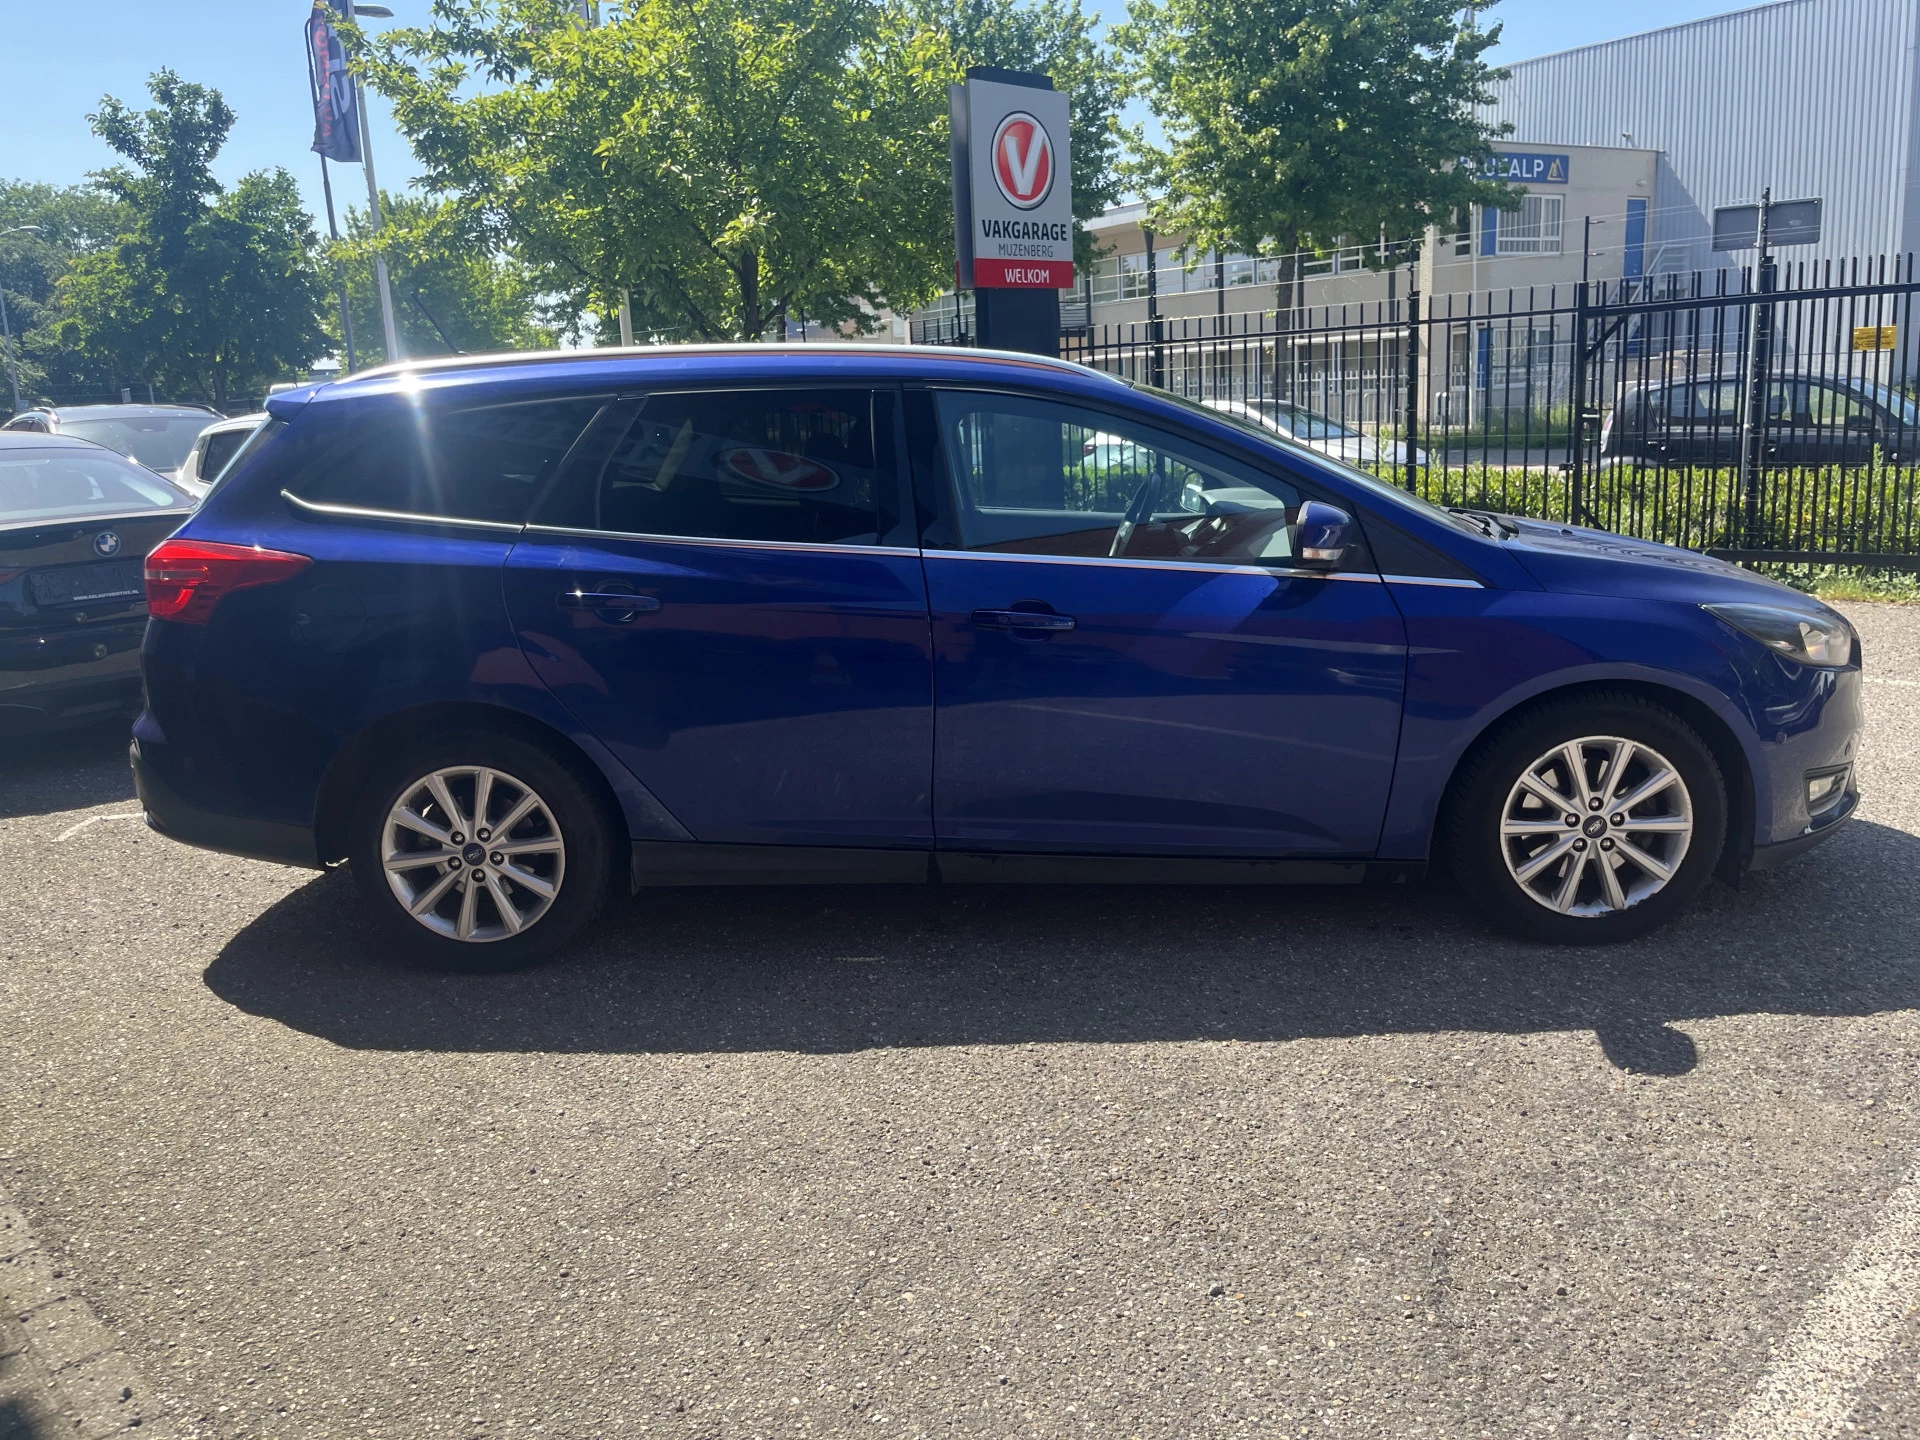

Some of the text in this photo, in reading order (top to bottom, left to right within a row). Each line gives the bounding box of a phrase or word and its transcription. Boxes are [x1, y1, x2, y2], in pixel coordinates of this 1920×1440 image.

[1004, 123, 1045, 196] V
[981, 219, 1067, 241] VAKGARAGE
[998, 243, 1054, 258] MUZENBERG
[1004, 268, 1050, 284] WELKOM
